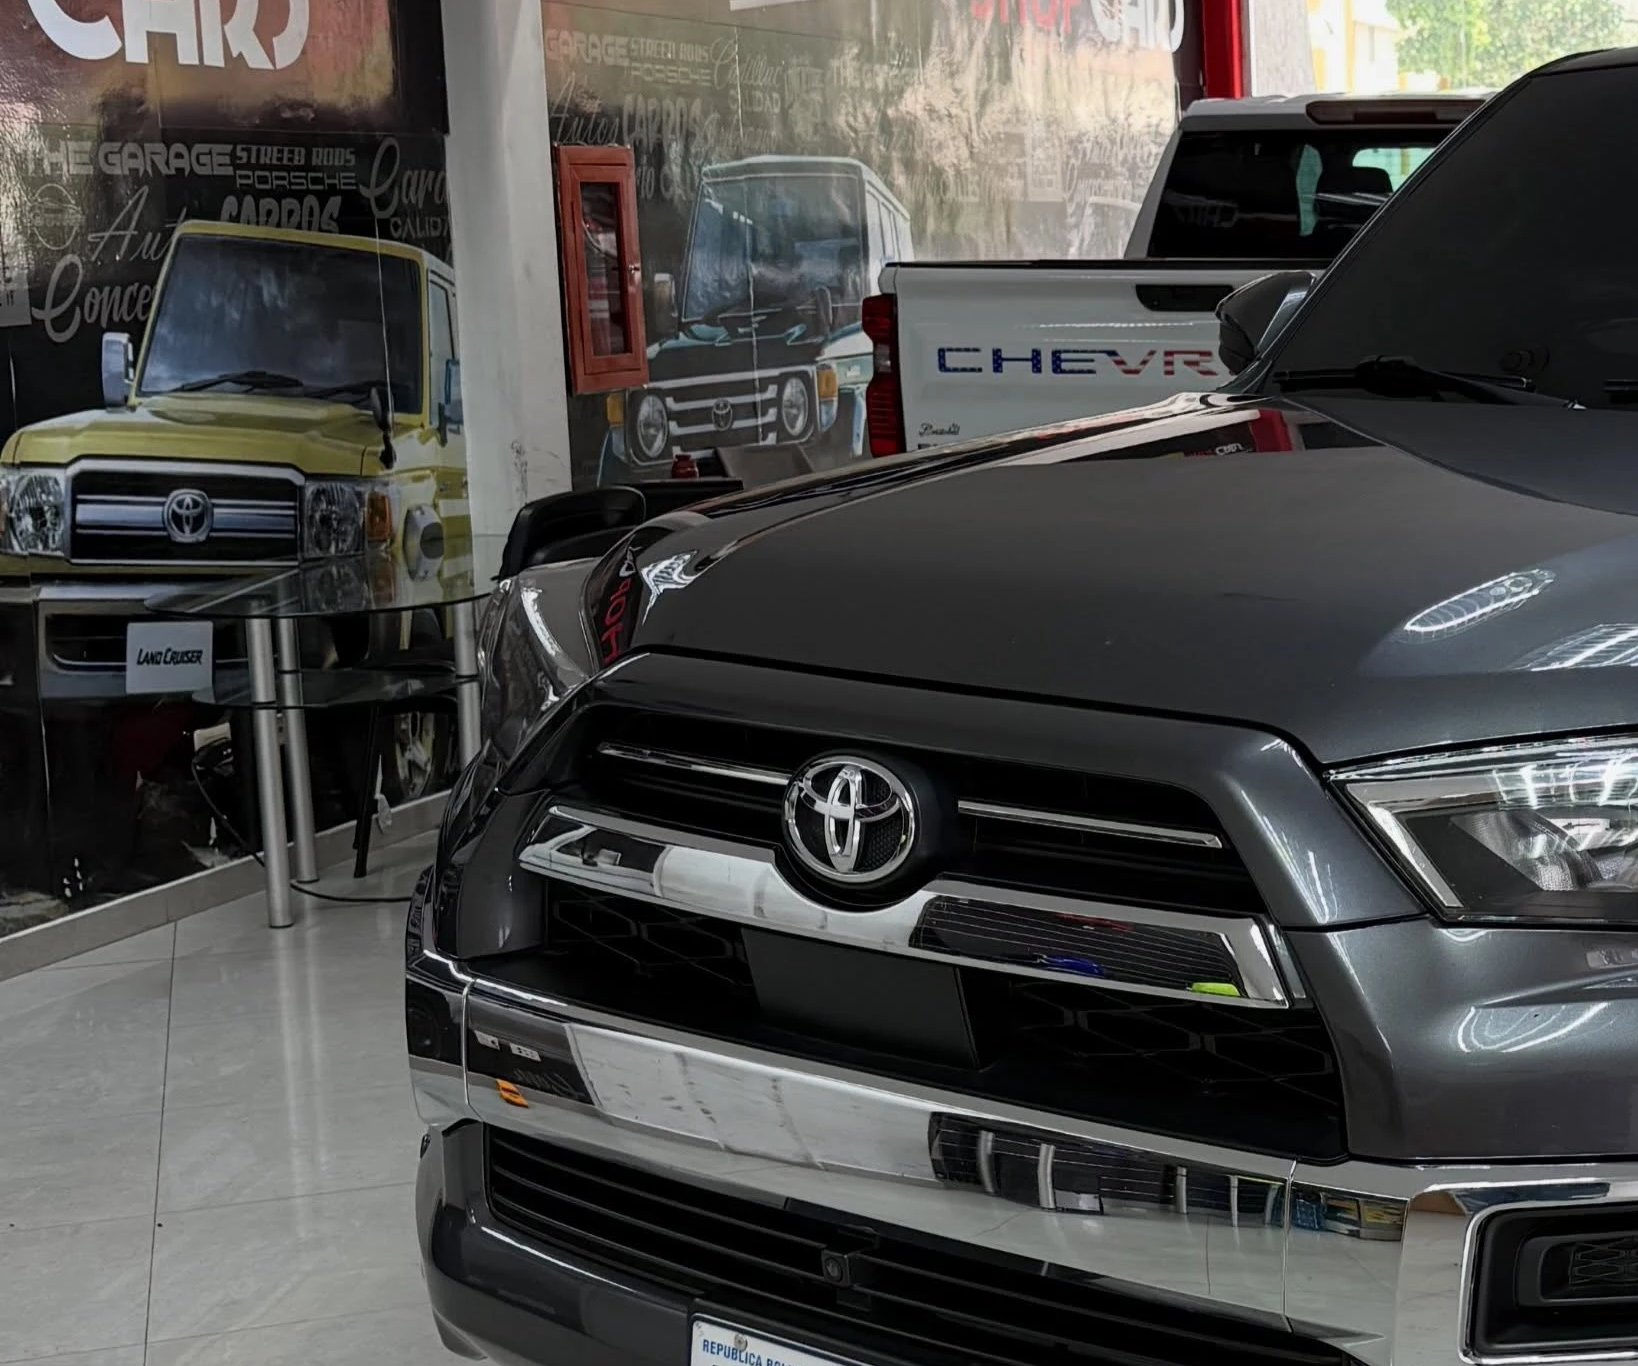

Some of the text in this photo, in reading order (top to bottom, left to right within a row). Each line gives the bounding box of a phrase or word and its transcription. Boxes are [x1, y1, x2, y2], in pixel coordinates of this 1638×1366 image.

[98, 142, 234, 177] GARAGE
[236, 170, 357, 190] PORSCHE
[937, 347, 1237, 377] CHEVR
